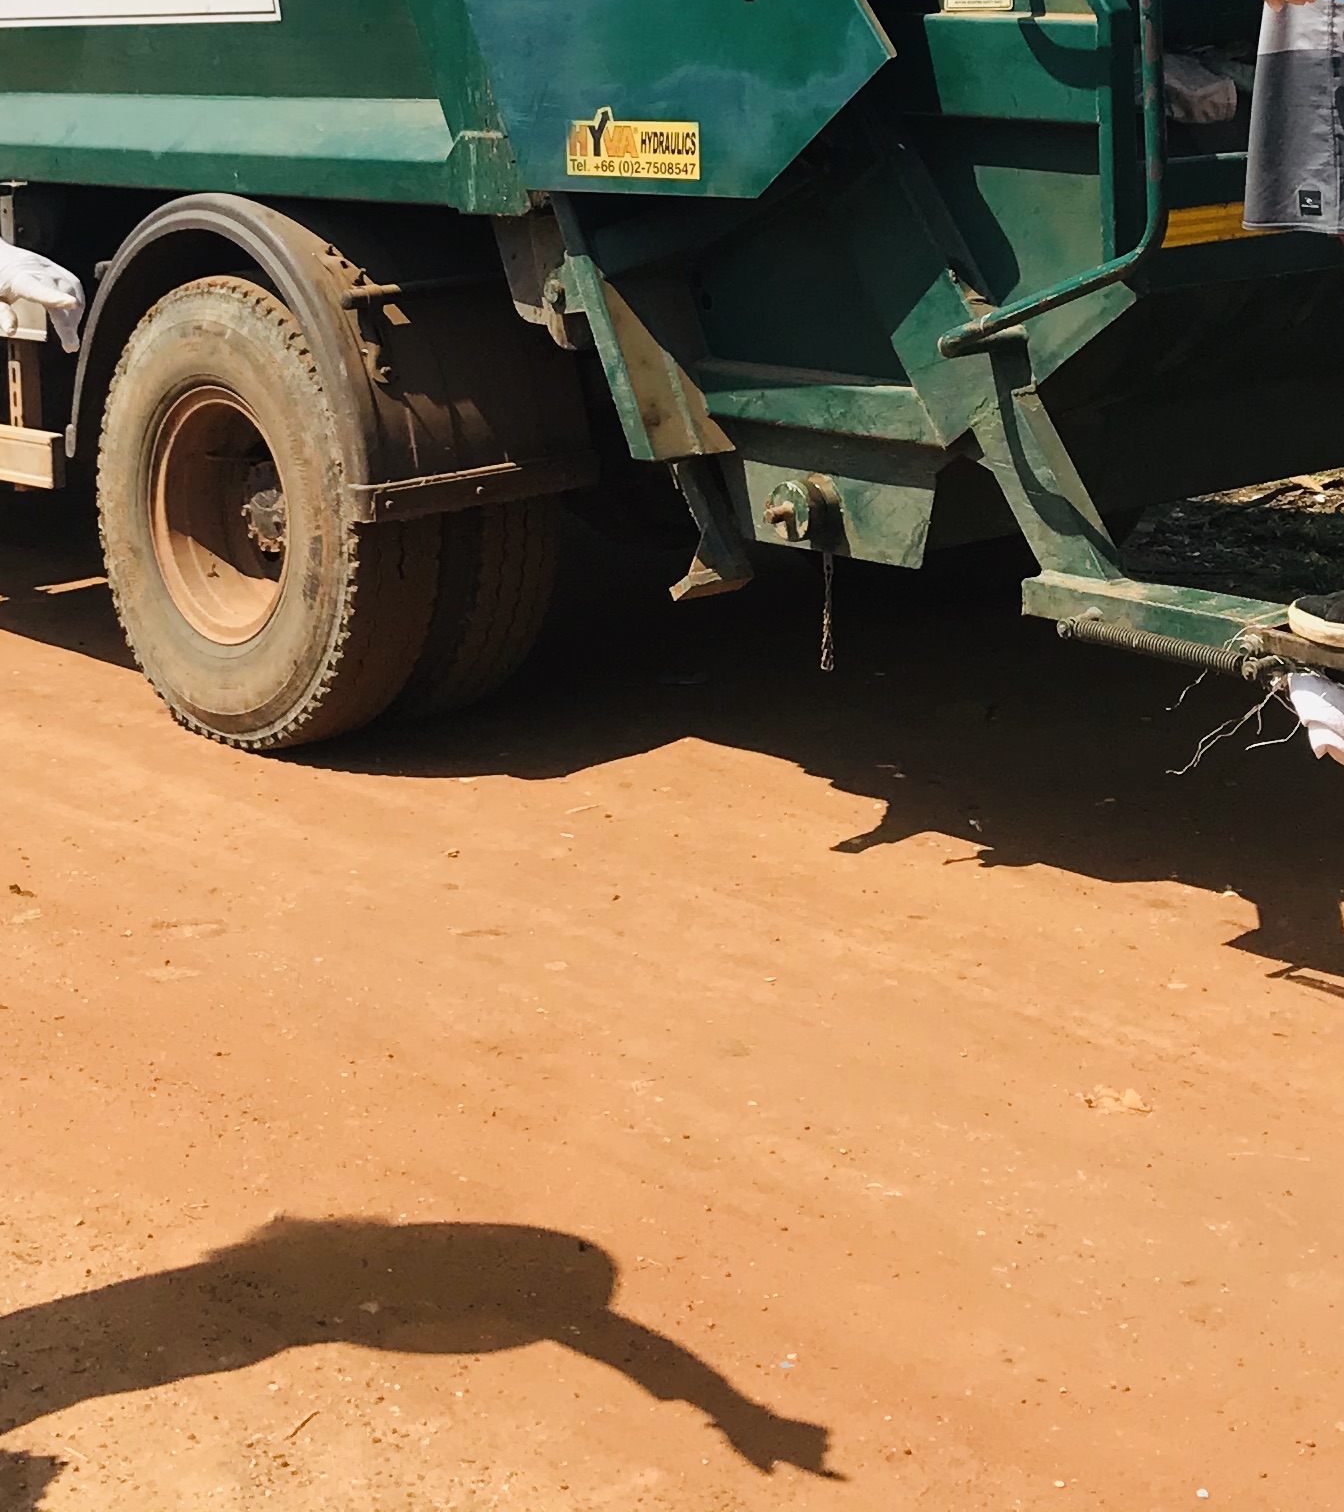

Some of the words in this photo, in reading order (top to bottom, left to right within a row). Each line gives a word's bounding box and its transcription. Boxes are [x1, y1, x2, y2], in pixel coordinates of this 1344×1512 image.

[640, 132, 696, 155] HYDRAULICS
[570, 159, 590, 171] Tel.
[594, 160, 615, 172] +66
[619, 161, 696, 176] (0)2-7508547
